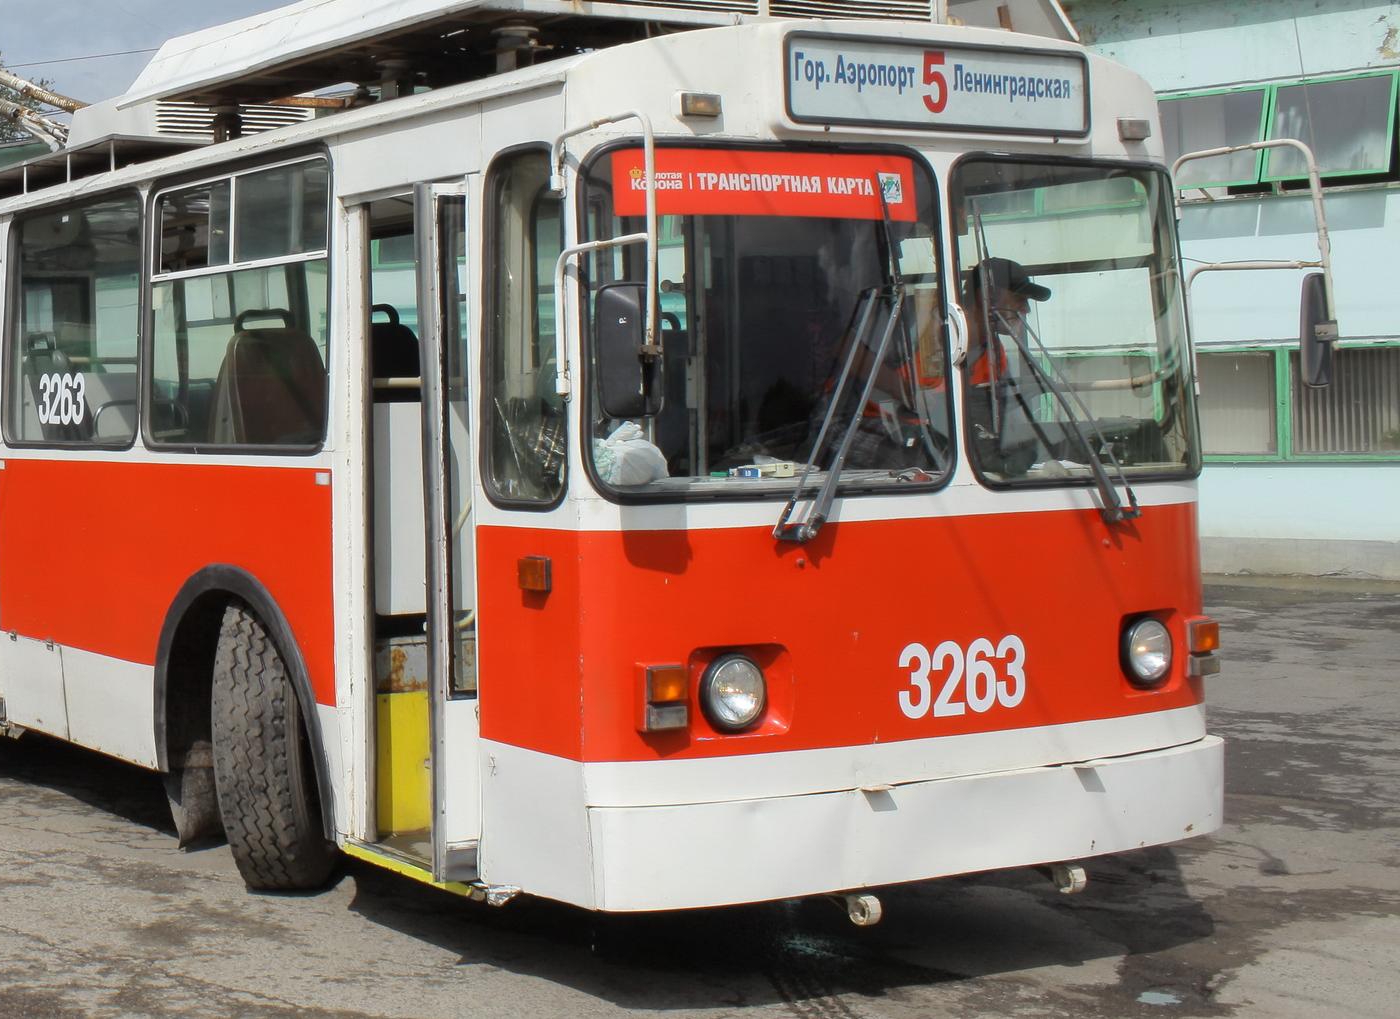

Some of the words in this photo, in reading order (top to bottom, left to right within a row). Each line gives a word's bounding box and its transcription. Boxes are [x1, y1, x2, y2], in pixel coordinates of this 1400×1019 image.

[794, 51, 830, 90] Гор.
[834, 54, 915, 95] Аэропорт
[922, 50, 948, 113] 5
[953, 64, 1071, 102] Ленинградская
[631, 178, 683, 190] Коона
[697, 172, 822, 194] ТРАНСПОРТНАЯ
[827, 176, 875, 196] КАРТА
[38, 372, 85, 425] 3263
[898, 634, 1026, 720] 3263
